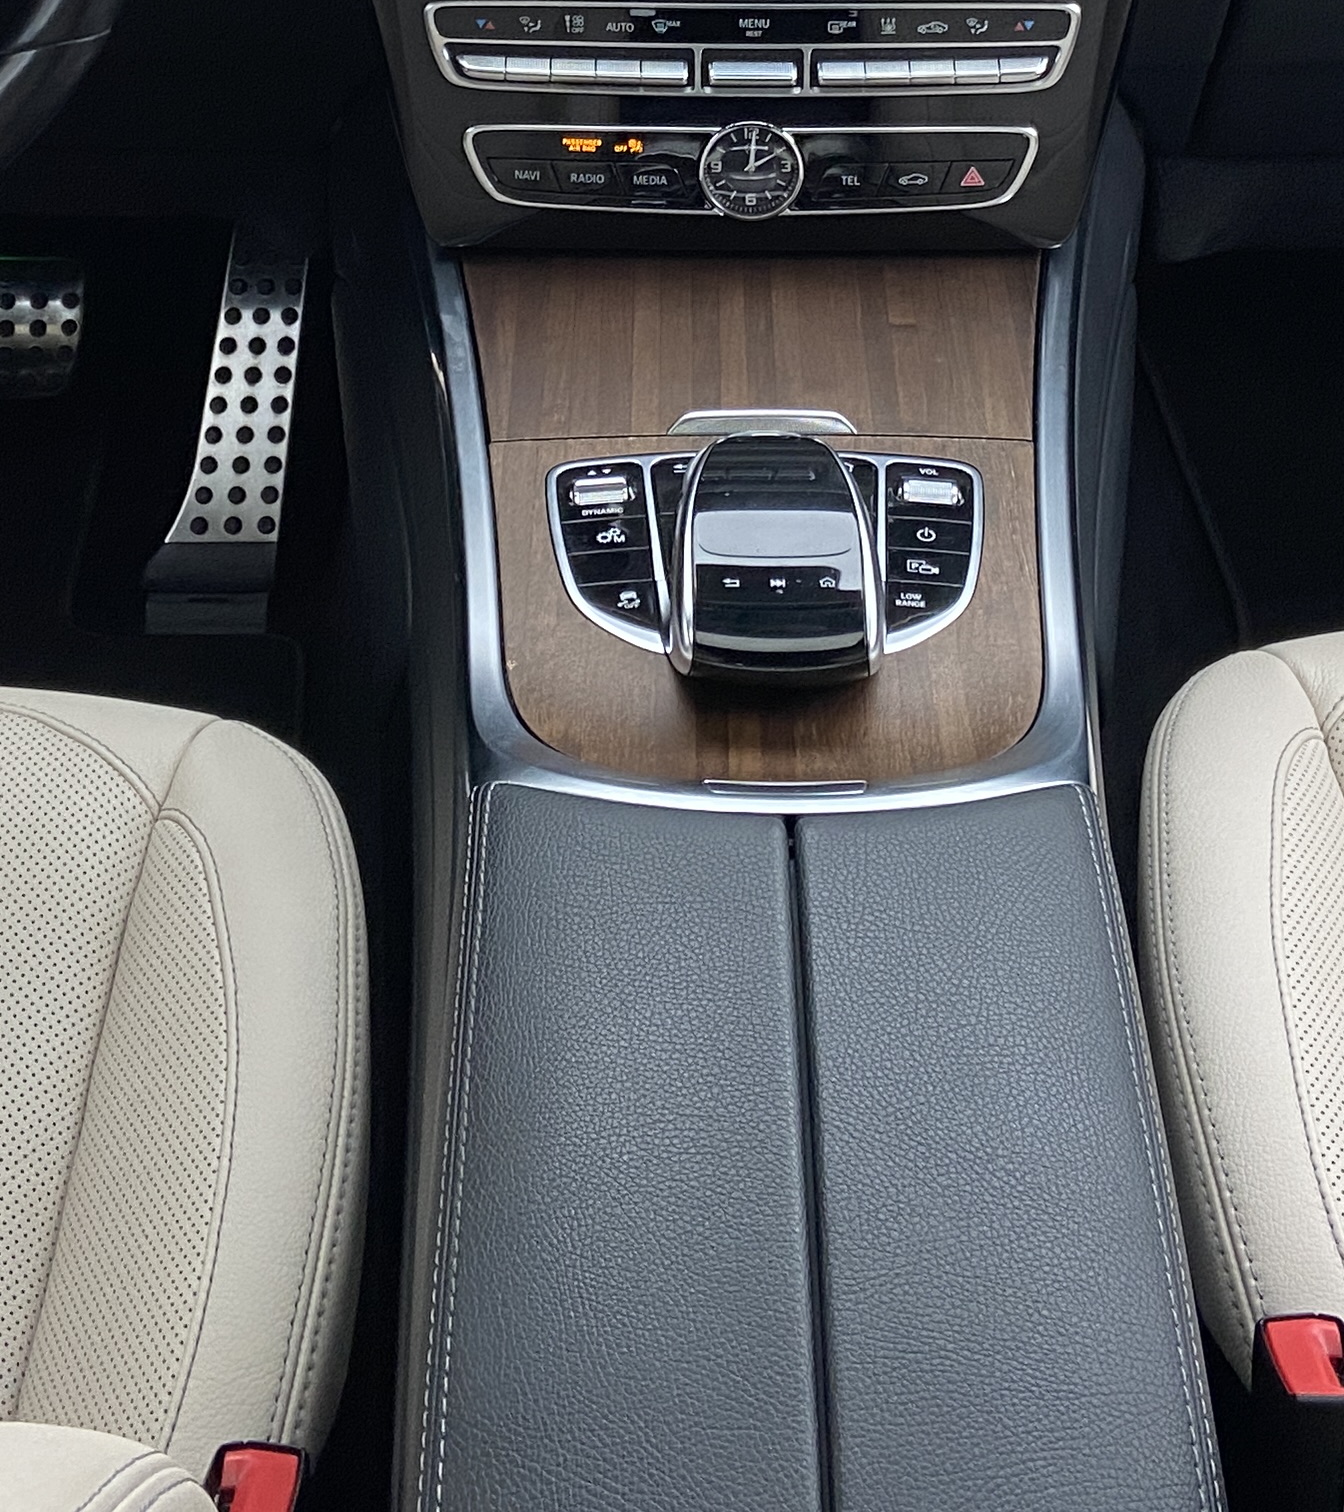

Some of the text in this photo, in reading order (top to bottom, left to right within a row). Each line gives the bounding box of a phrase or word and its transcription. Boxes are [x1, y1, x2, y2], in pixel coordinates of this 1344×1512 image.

[605, 22, 635, 33] AUTO
[738, 18, 770, 29] MENU
[710, 160, 723, 173] 9
[780, 160, 792, 173] 3
[514, 169, 541, 181] NAVI
[570, 172, 605, 184] RADIO
[633, 174, 668, 186] MEDIA
[840, 174, 861, 186] TEL
[745, 193, 757, 206] 6
[918, 467, 939, 476] VOL
[581, 507, 624, 516] DYNAMIC
[900, 592, 923, 600] LOW
[895, 598, 926, 608] RANGE
